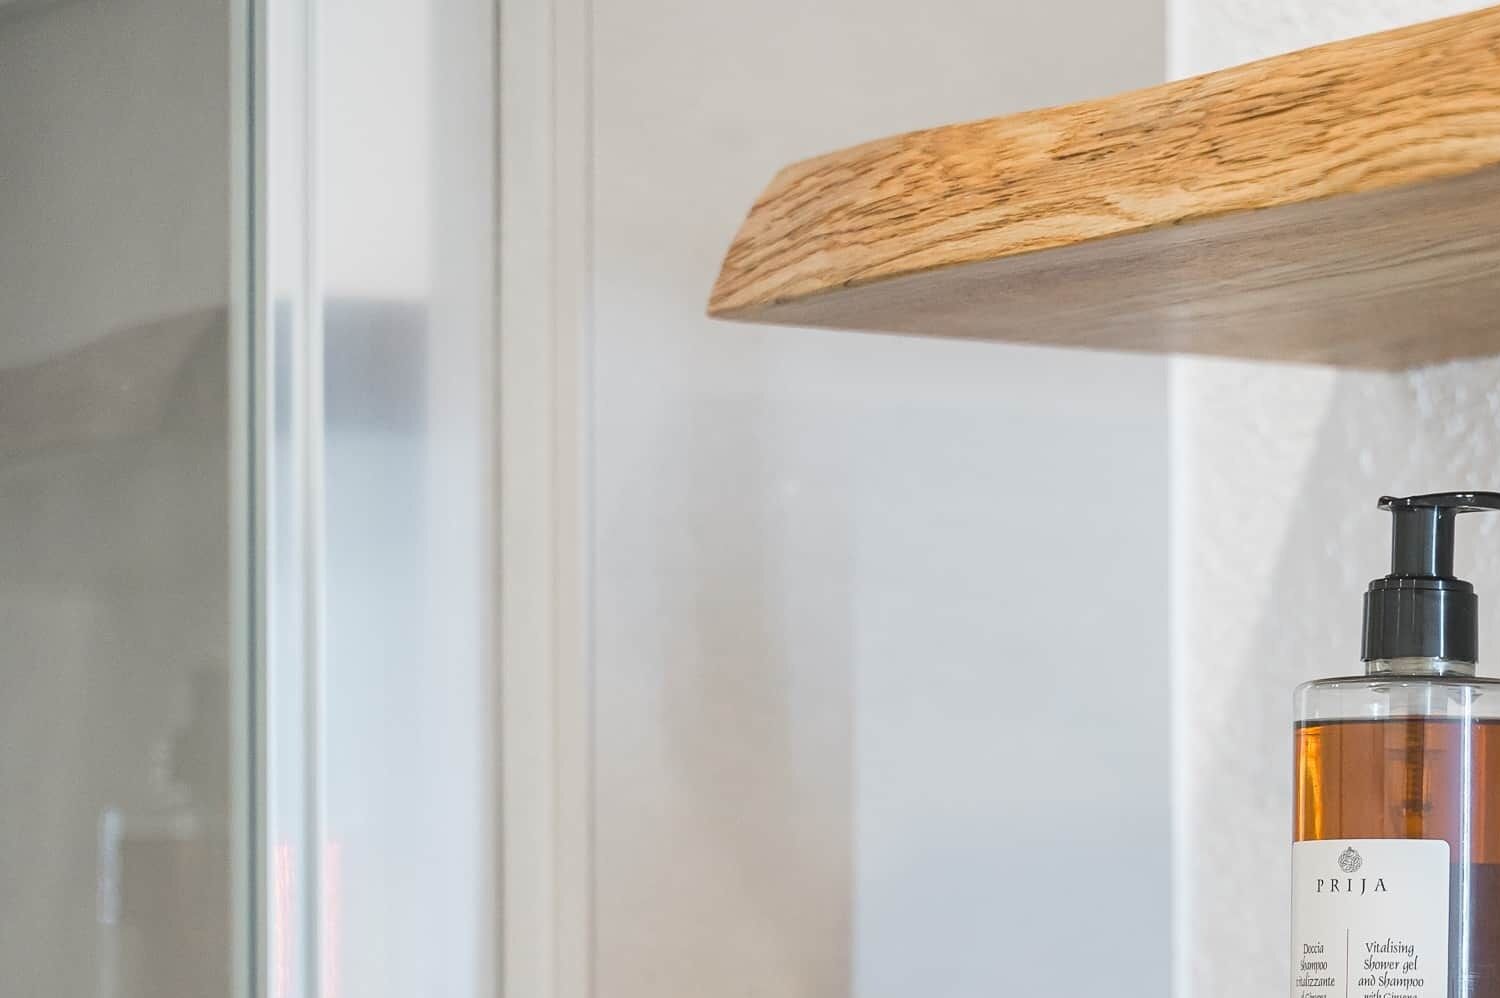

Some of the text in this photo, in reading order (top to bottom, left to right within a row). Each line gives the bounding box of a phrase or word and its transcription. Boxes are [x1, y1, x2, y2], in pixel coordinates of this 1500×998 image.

[1316, 878, 1387, 895] PRIJA
[1365, 938, 1414, 956] Vitalising
[1363, 954, 1418, 974] Shower gel
[1358, 971, 1424, 990] and Shampoo
